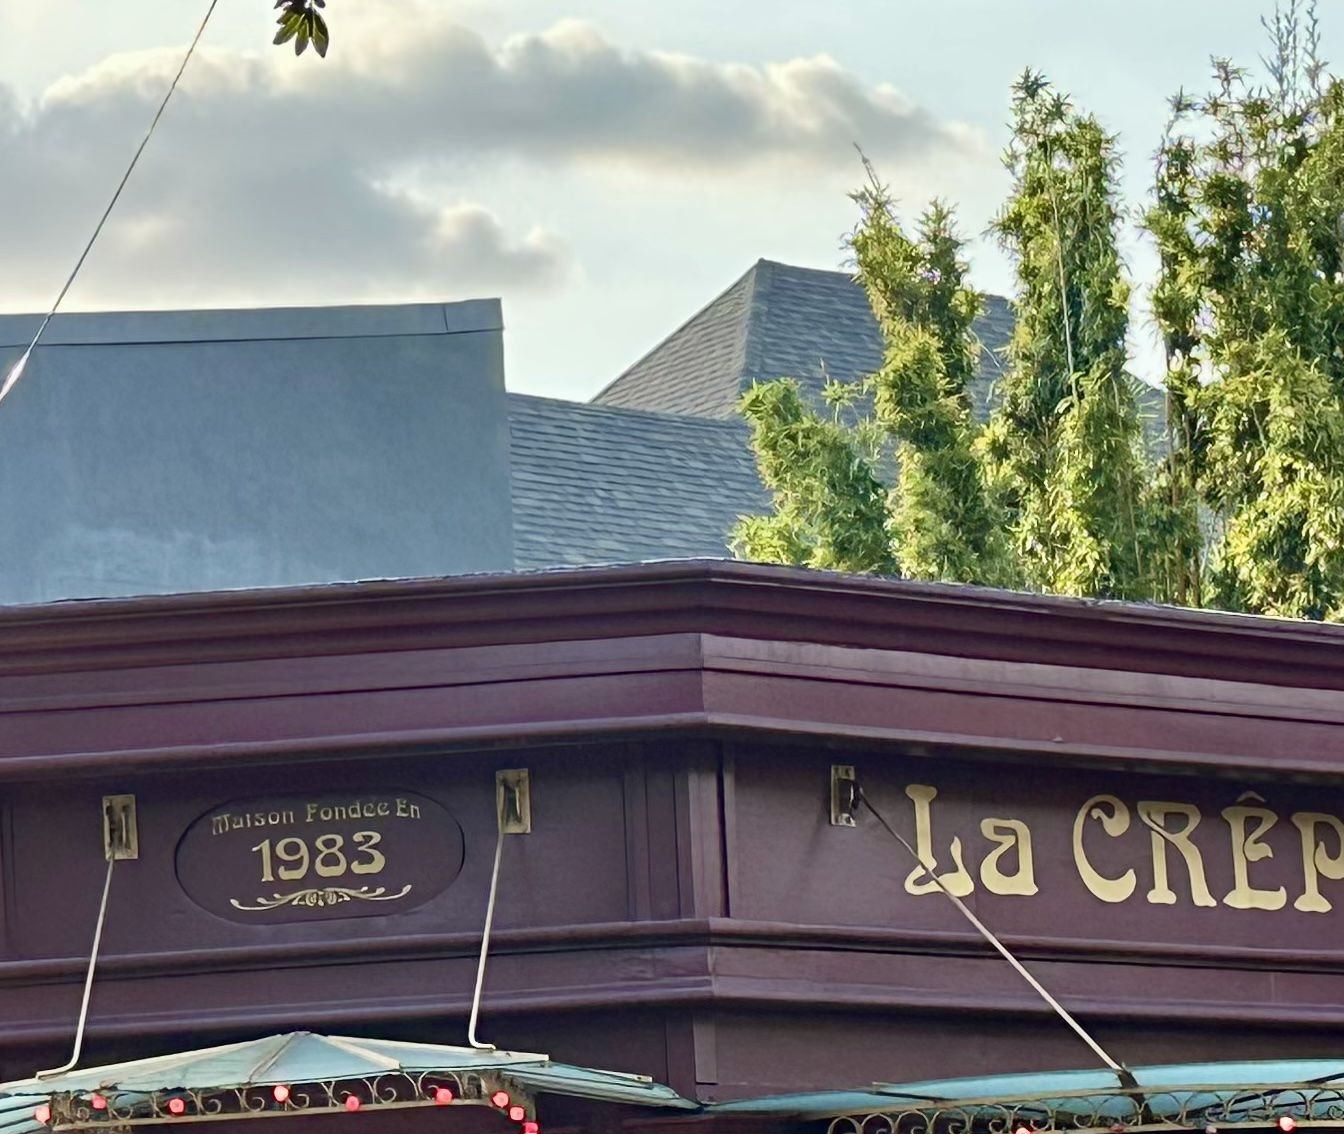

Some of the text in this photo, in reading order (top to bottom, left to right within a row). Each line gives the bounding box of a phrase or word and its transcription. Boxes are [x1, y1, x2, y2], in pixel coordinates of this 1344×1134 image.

[396, 799, 422, 819] En
[252, 831, 387, 882] 1983
[903, 784, 1039, 897] La
